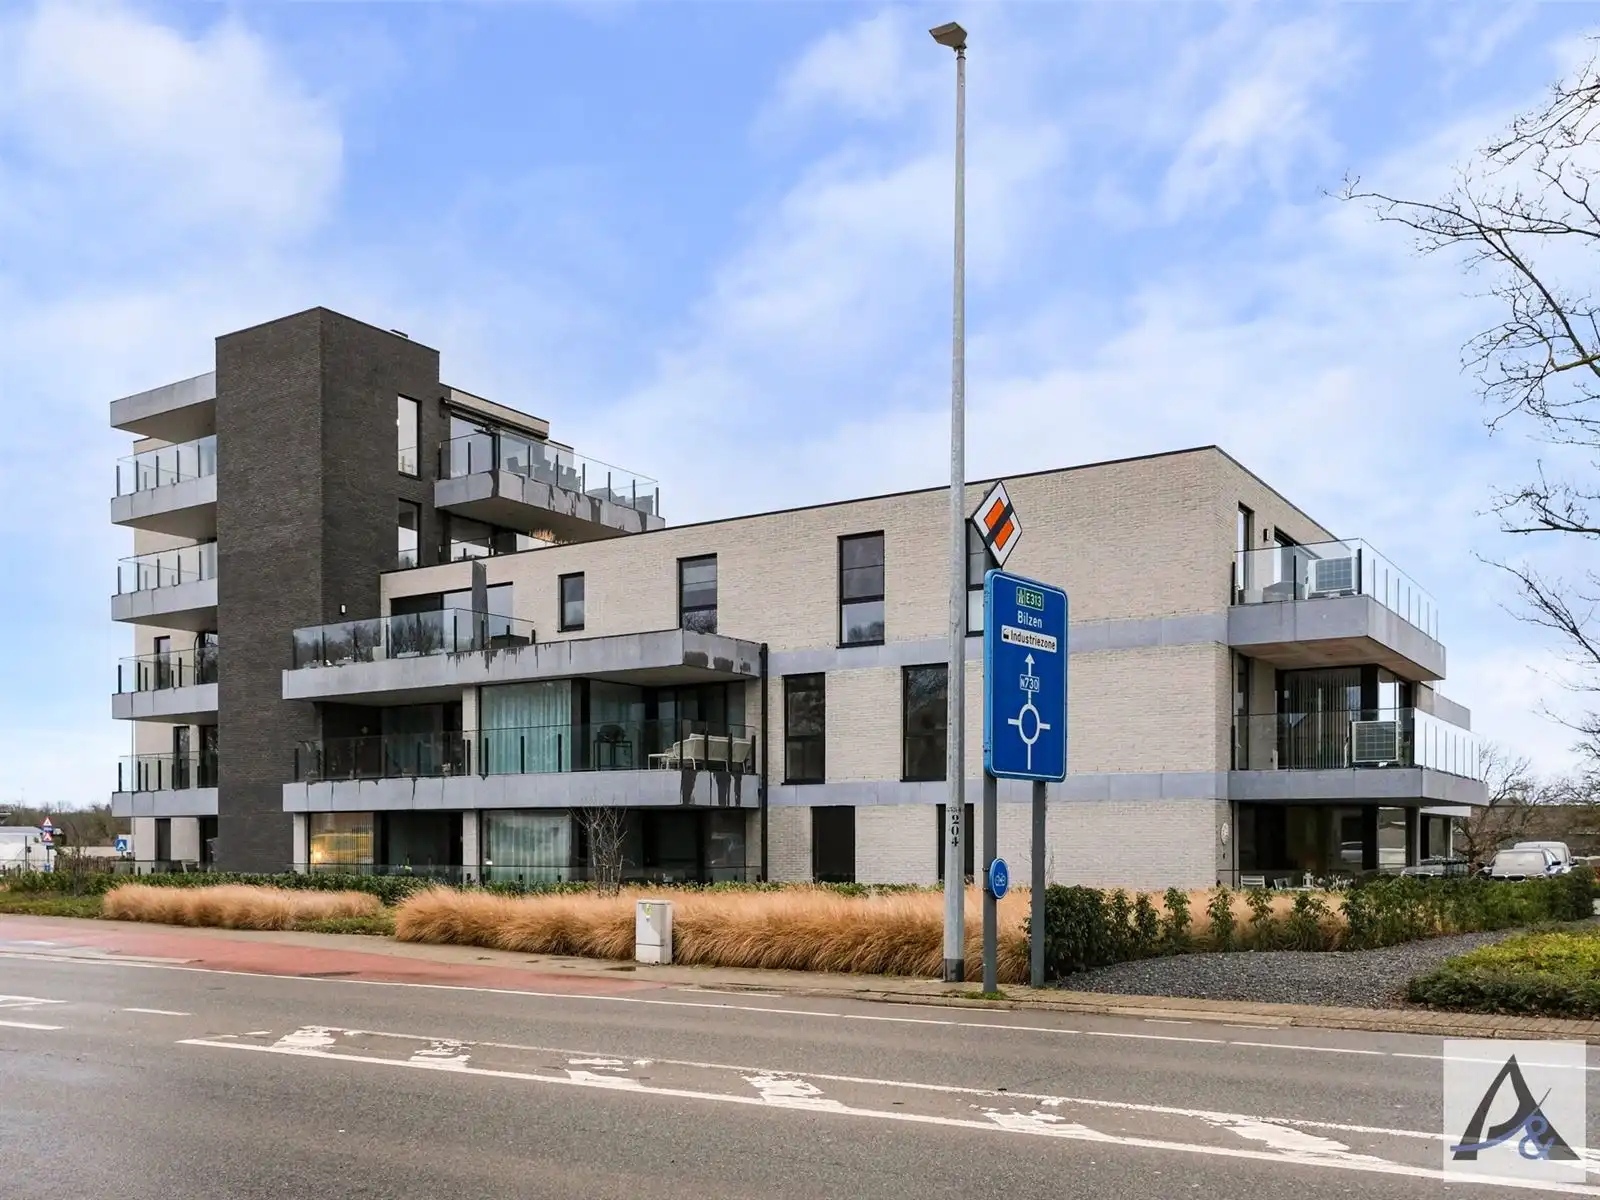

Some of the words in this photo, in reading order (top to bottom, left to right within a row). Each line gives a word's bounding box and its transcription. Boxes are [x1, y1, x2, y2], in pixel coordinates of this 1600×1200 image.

[1026, 593, 1042, 607] E313
[1017, 610, 1042, 628] Bilzen
[1010, 630, 1056, 650] Industriezone
[1020, 678, 1039, 691] N730
[951, 814, 959, 847] 204
